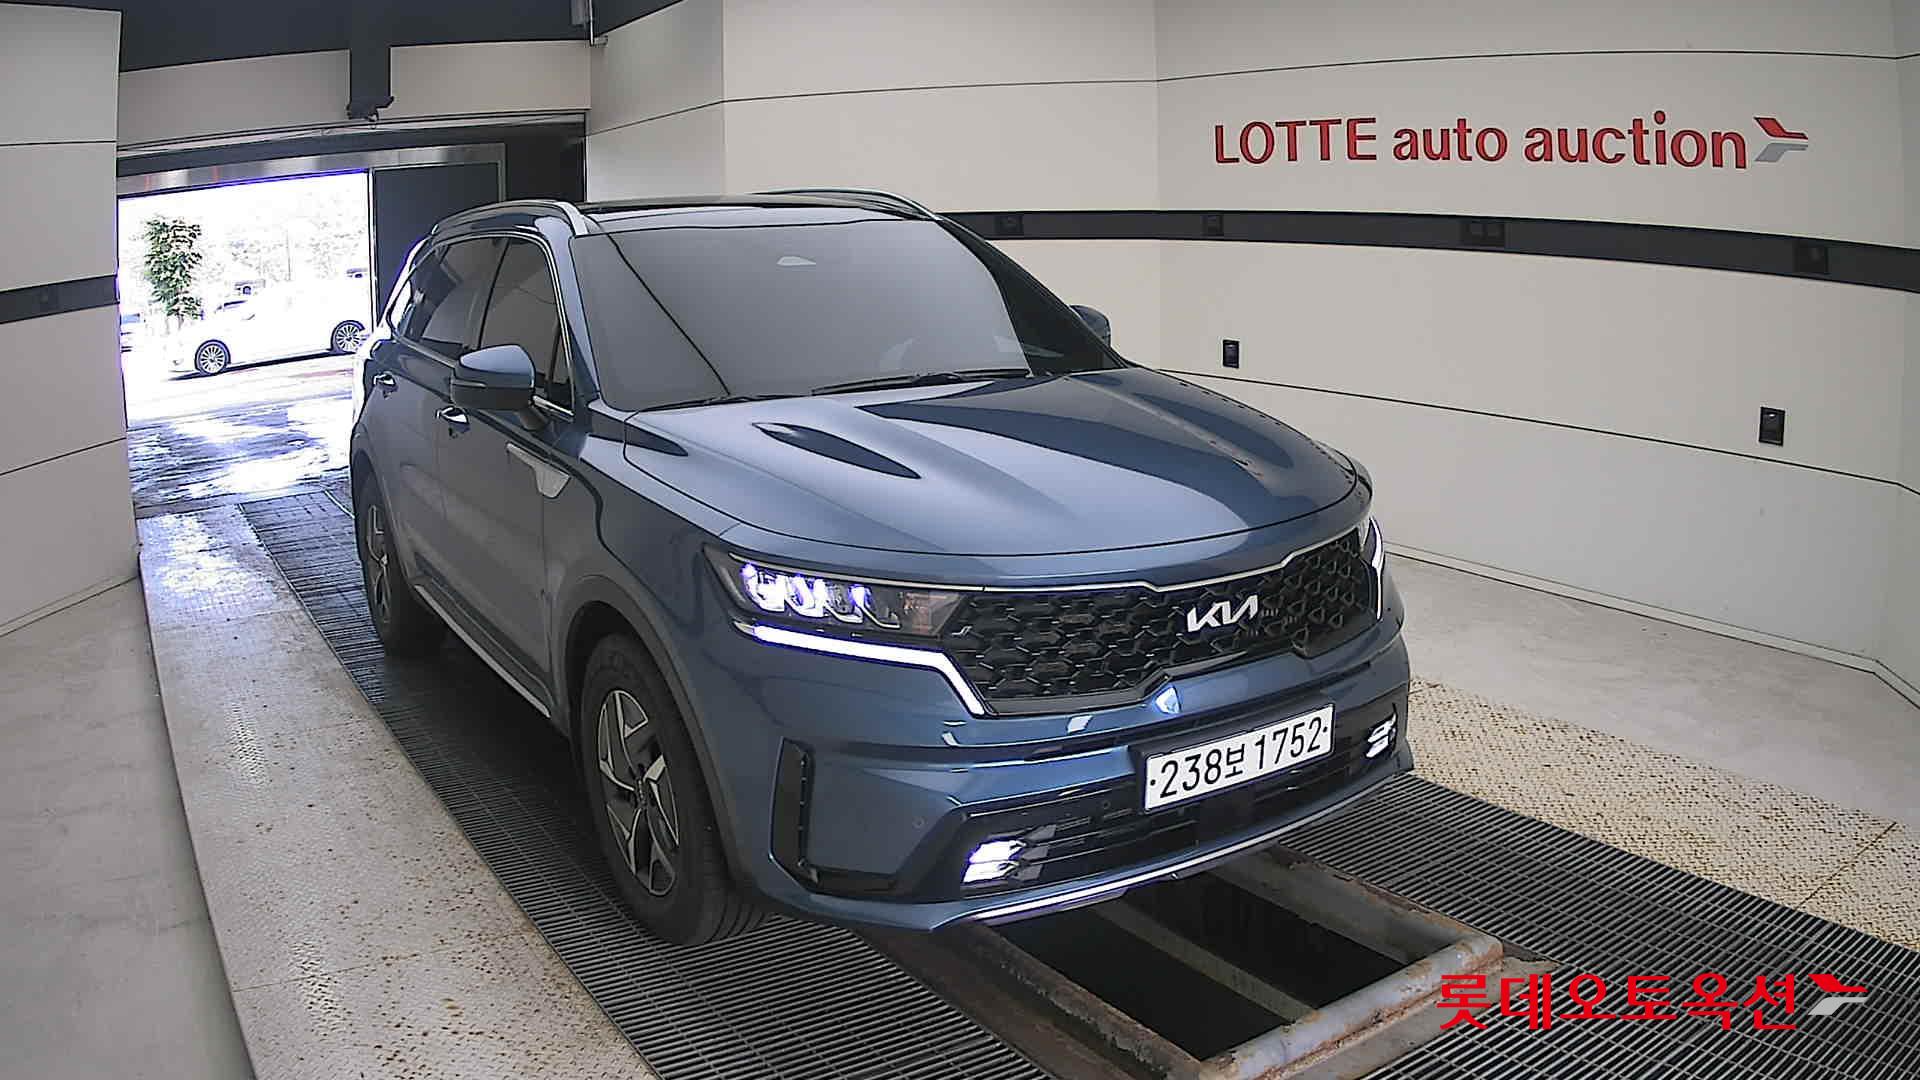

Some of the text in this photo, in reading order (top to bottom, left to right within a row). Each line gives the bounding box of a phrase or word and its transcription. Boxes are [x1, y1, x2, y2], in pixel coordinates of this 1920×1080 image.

[1214, 110, 1748, 169] LOTTE auto auction
[1187, 594, 1258, 632] KIA
[1159, 716, 1322, 799] 238보 1752
